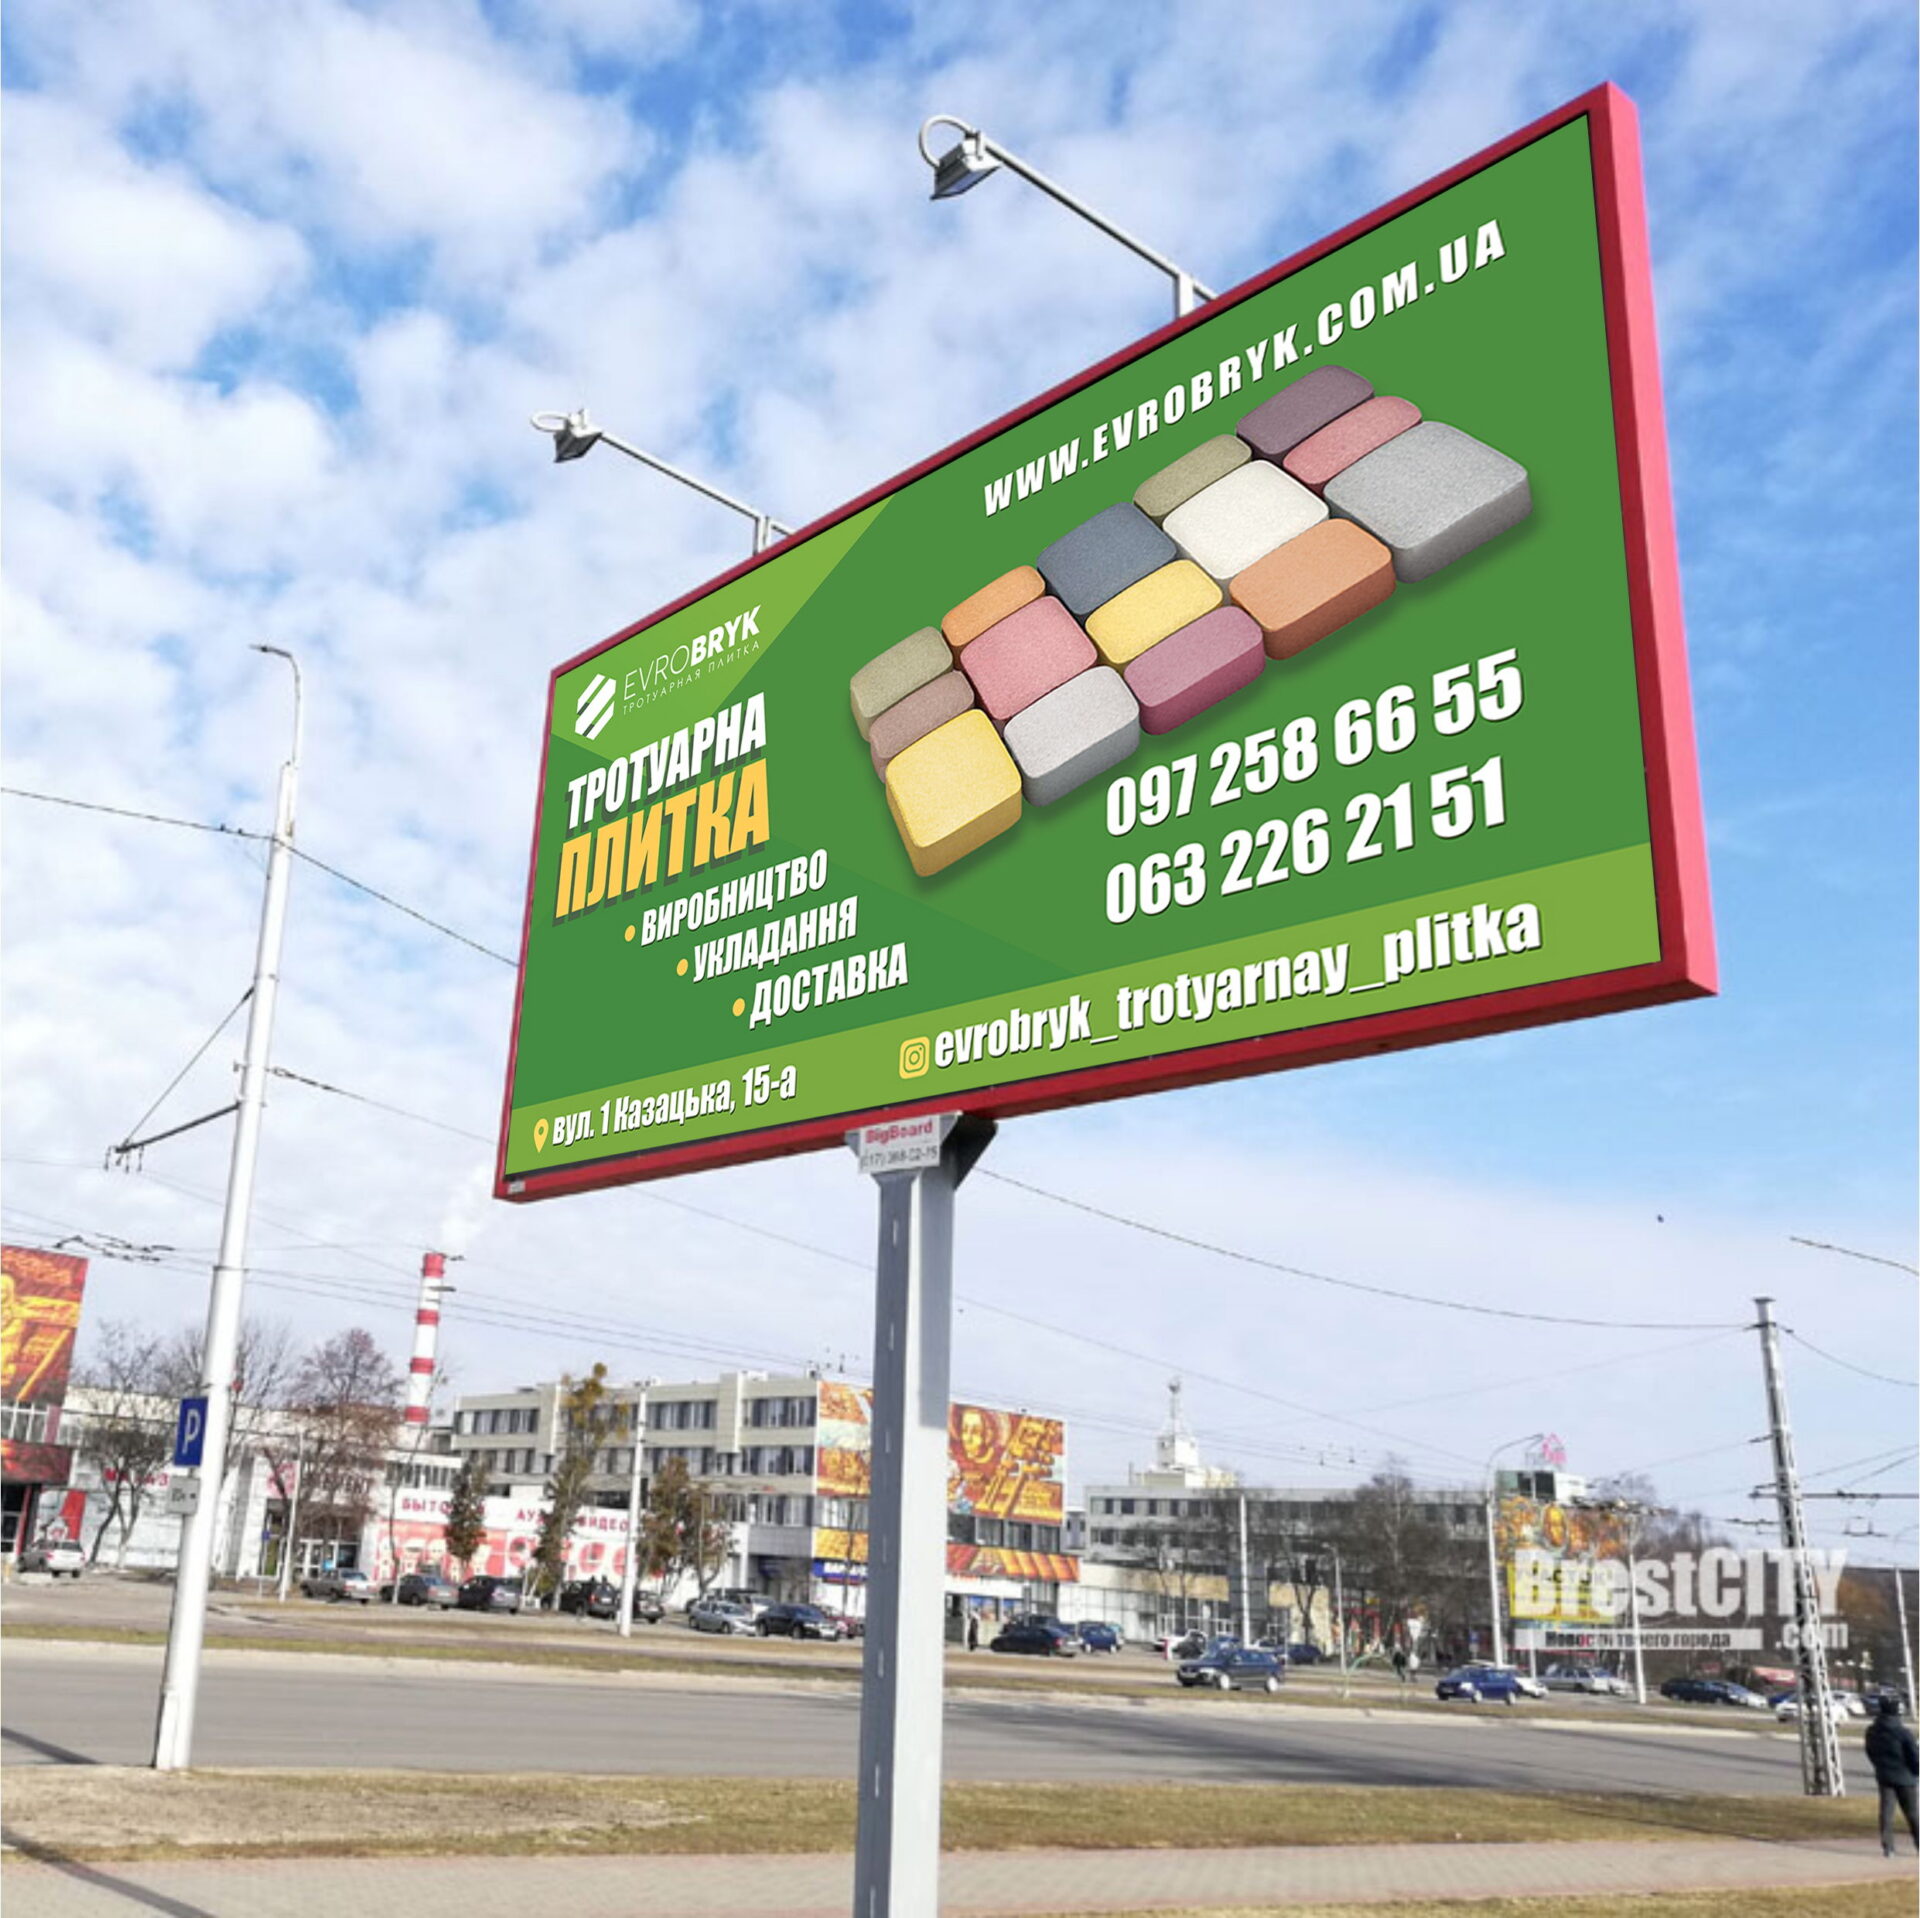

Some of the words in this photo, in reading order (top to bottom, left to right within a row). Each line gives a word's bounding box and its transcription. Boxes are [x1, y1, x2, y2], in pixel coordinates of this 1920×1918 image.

[983, 219, 1506, 517] WWW.EVROBRYK.COM.UA
[623, 604, 761, 701] EVROBRYK
[623, 669, 701, 715] ТРОТУАРНАЯ
[708, 640, 760, 673] ПЛИТКА
[566, 691, 768, 831] ТРОТУАРНА
[1106, 754, 1198, 837] 097
[1209, 716, 1319, 807] 258
[1333, 684, 1417, 766] 66
[1432, 648, 1524, 737] 55
[554, 757, 771, 920] ПЛИТКА
[1105, 842, 1207, 925] 063
[1219, 807, 1331, 897] 226
[1344, 781, 1415, 865] 21
[1430, 755, 1506, 839] 51
[640, 848, 829, 946] ВИРОБНИЦТВО
[692, 896, 859, 983] УКЛАДАННЯ
[749, 942, 909, 1029] ДОСТАВКА
[934, 902, 1542, 1069] evrobryk_trotyarnay_plitka
[552, 1110, 595, 1147] вул.
[600, 1100, 611, 1135] 1
[613, 1079, 736, 1134] Казацька,
[742, 1064, 797, 1107] 15-а
[865, 1119, 933, 1145] BigBoard
